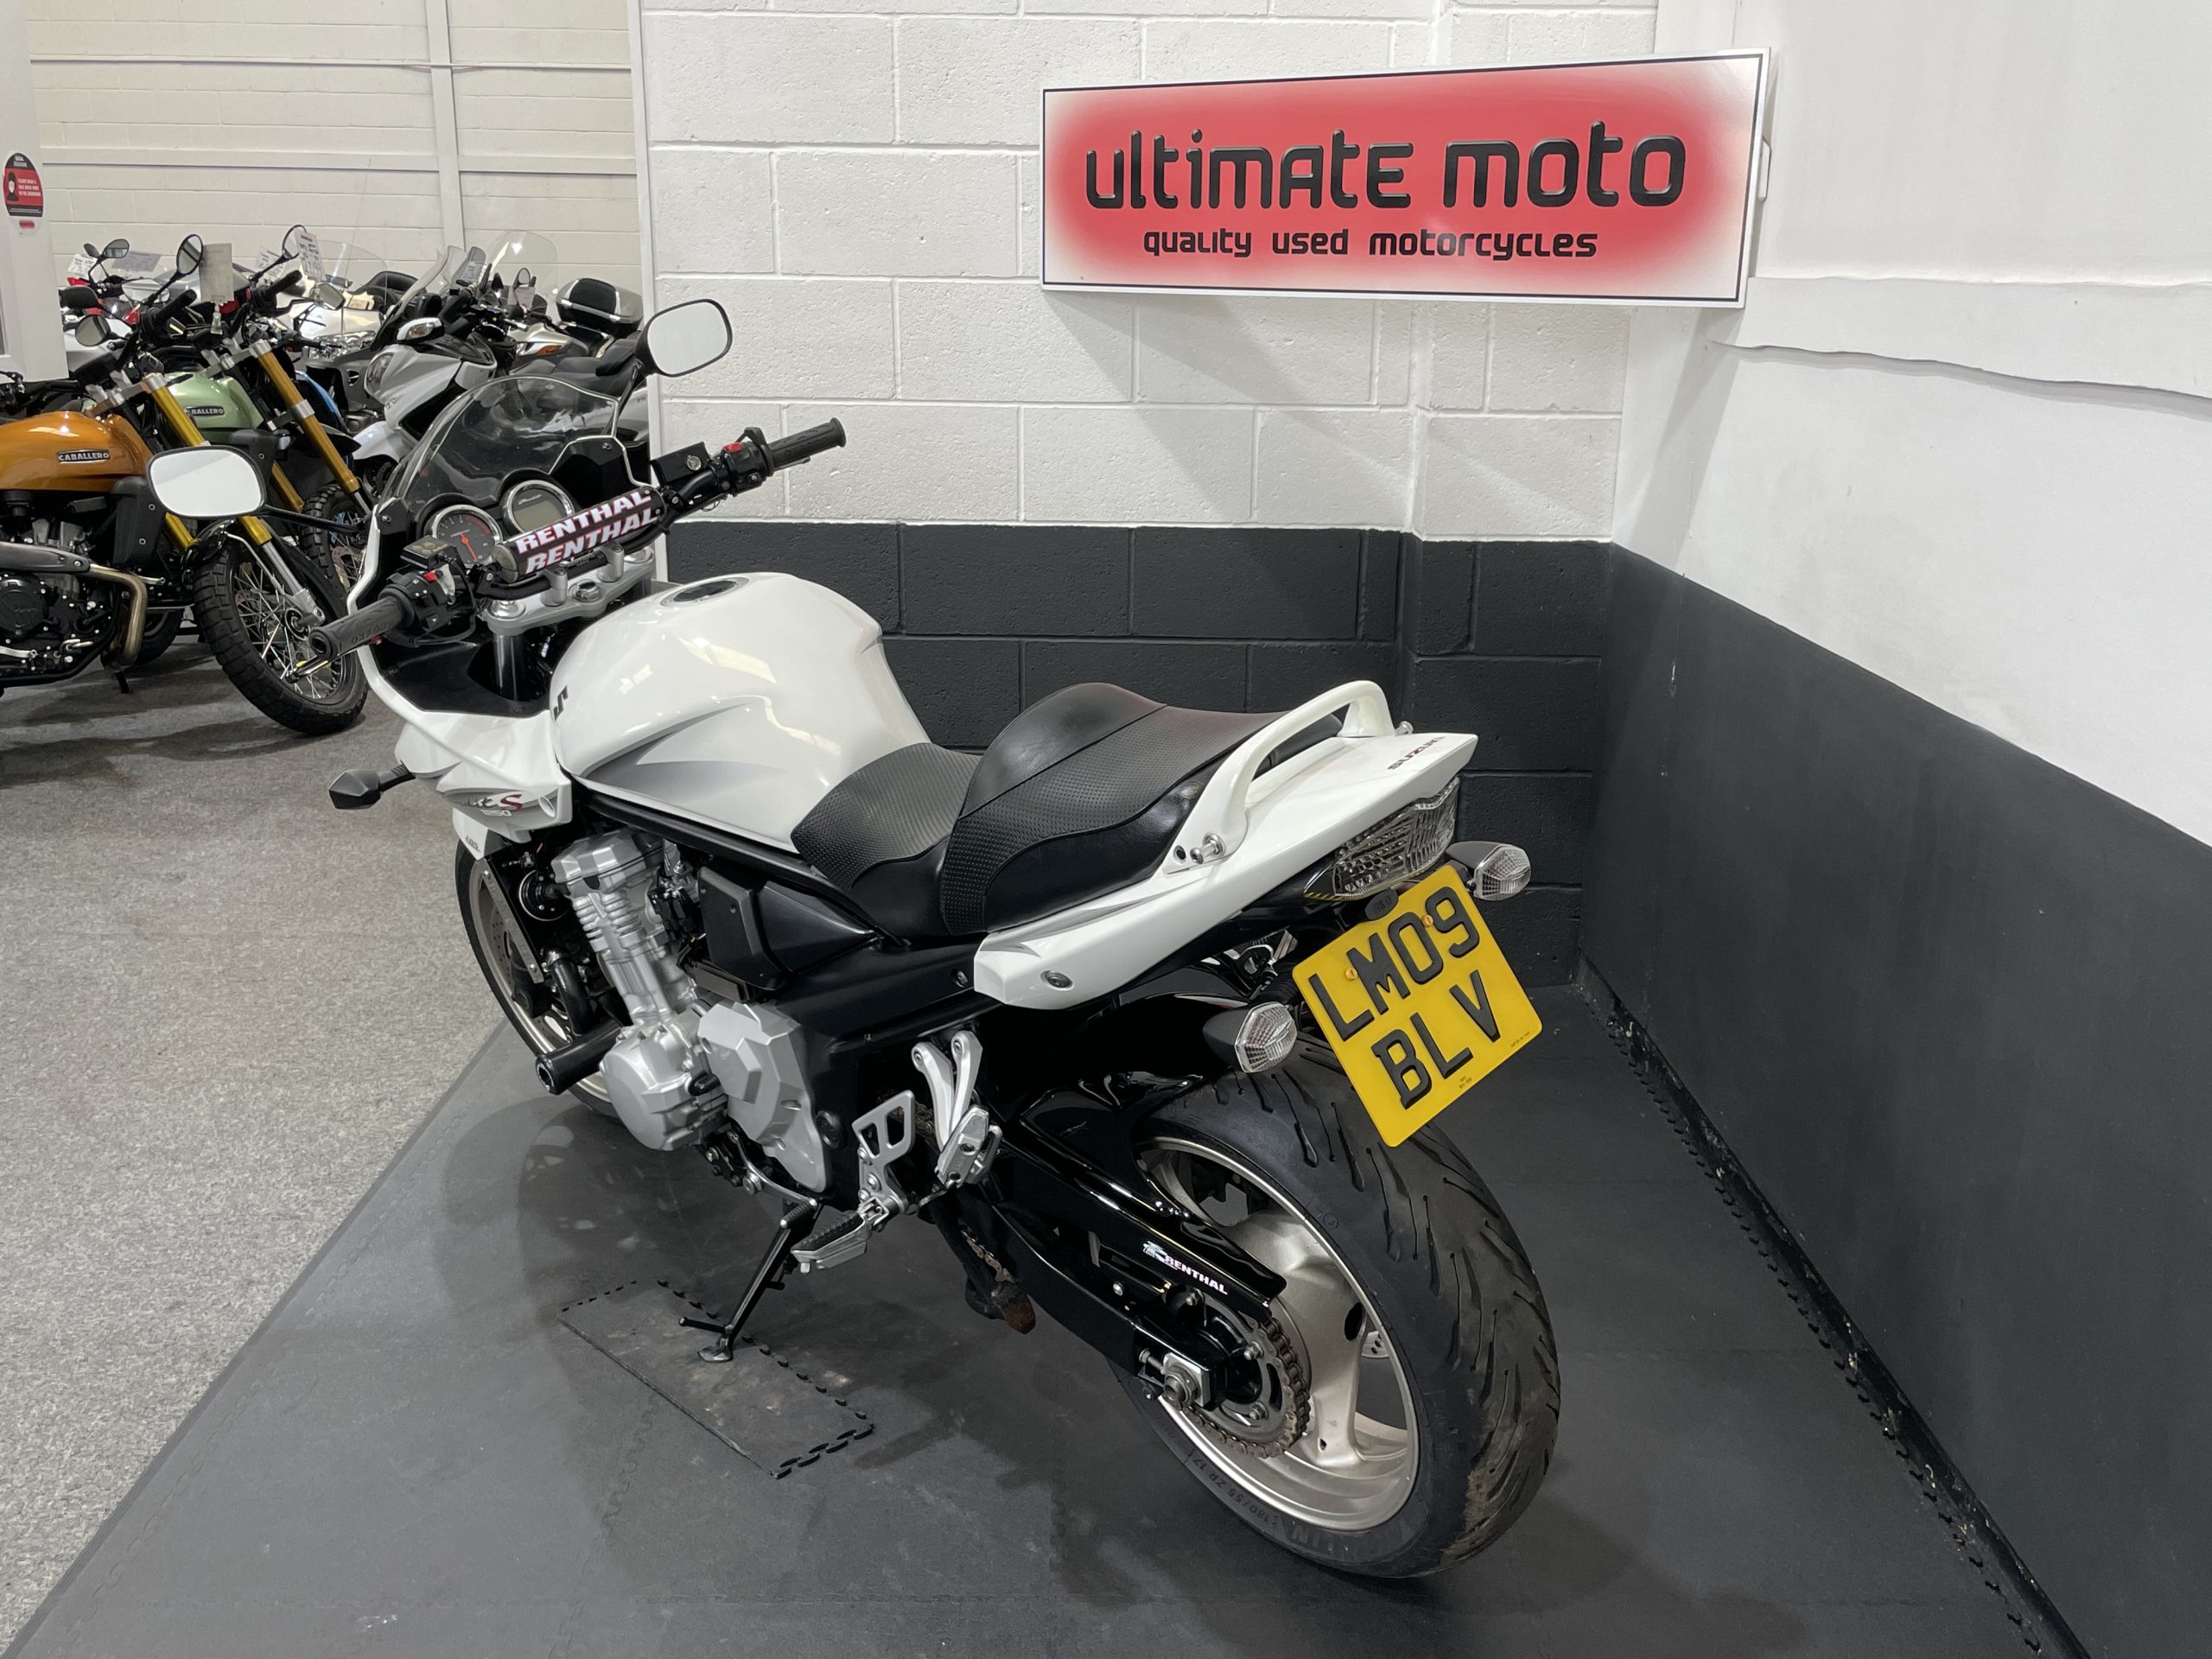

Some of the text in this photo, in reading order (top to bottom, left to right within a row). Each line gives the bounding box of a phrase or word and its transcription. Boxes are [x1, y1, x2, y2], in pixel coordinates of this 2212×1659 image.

[1442, 121, 1686, 208] moto
[1271, 228, 1349, 257] used
[58, 452, 110, 462] CABALLERO
[515, 490, 652, 555] RENTHAL
[525, 507, 658, 575] RENTHAL
[1308, 886, 1480, 1041] LM09
[1372, 969, 1500, 1109] BLV
